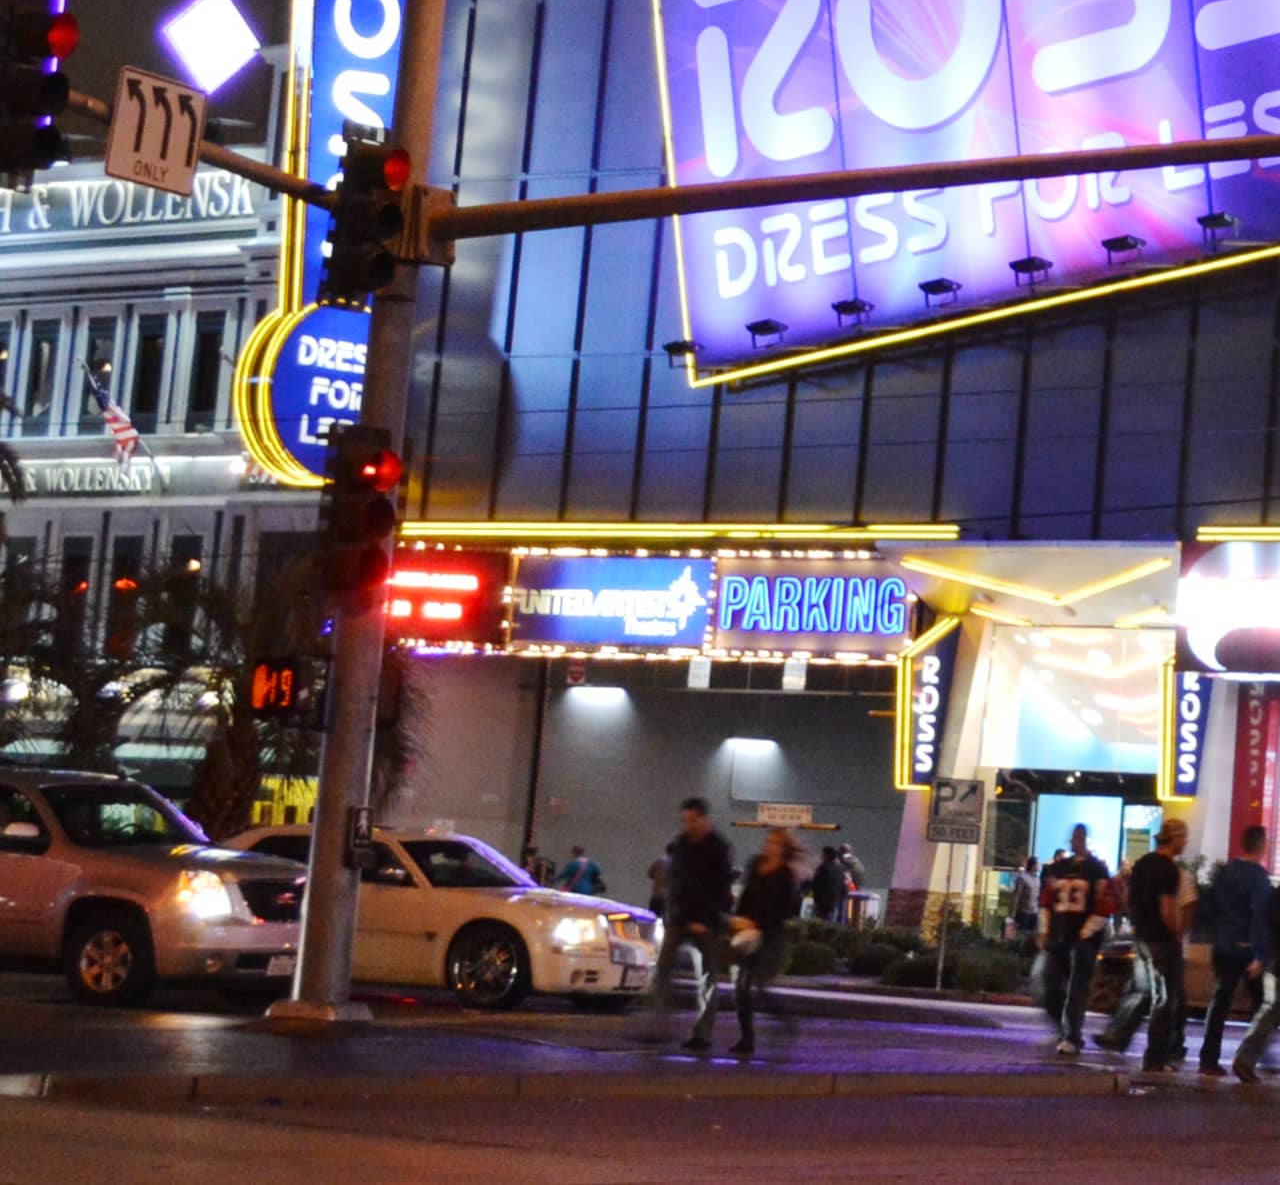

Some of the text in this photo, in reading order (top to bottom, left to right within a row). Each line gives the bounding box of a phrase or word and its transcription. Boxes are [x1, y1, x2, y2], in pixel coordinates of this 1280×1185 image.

[134, 160, 169, 183] ONLY
[714, 189, 949, 299] DRESS
[298, 335, 367, 374] DRES
[719, 576, 906, 634] PARKING
[915, 655, 941, 772] ROSS
[1178, 671, 1202, 783] ROSS
